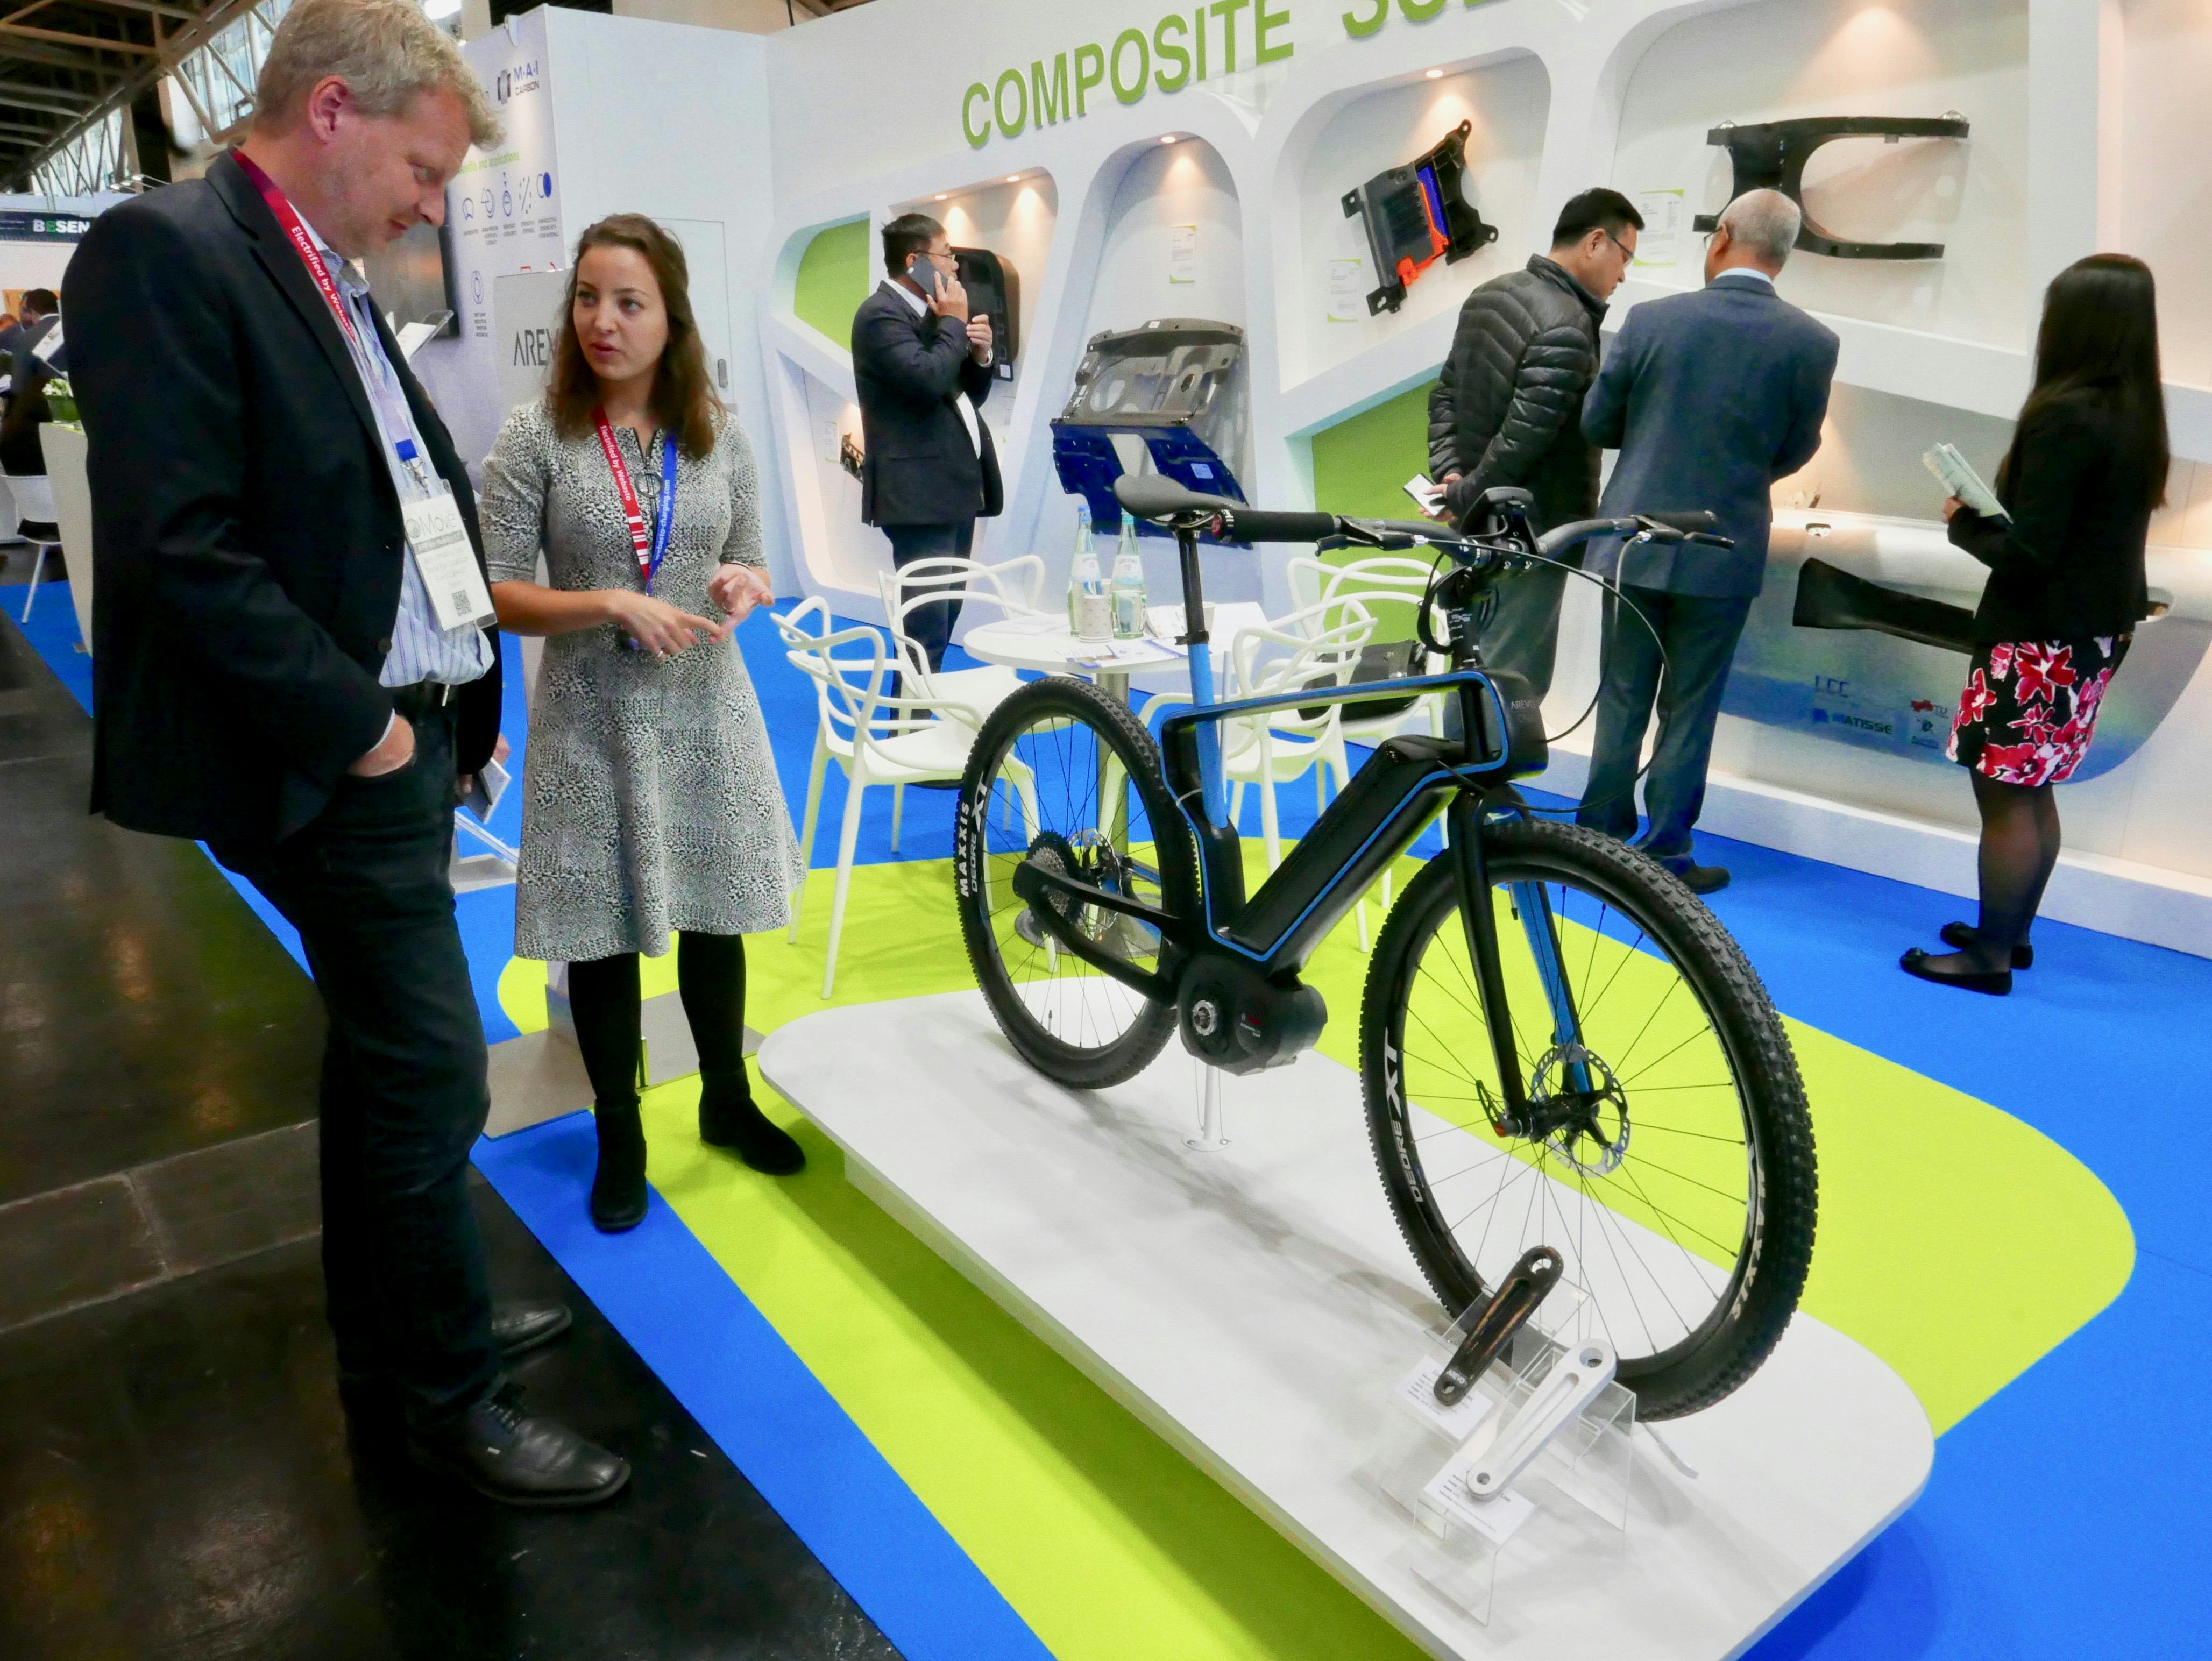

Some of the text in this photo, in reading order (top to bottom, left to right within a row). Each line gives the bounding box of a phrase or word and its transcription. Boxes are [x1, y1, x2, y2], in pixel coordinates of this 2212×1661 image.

[515, 80, 540, 96] CARBON
[962, 0, 1294, 148] COMPOSITE
[32, 219, 91, 233] BESEN
[291, 225, 326, 277] Electrified
[321, 278, 332, 292] by
[600, 425, 632, 502] Electrified by Webasto
[655, 479, 671, 561] webasto-charging.com
[1832, 711, 1894, 735] MATISSE
[958, 801, 970, 898] MAXXIS
[970, 770, 988, 893] DEORE XT
[1384, 1026, 1424, 1203] DEORE XT
